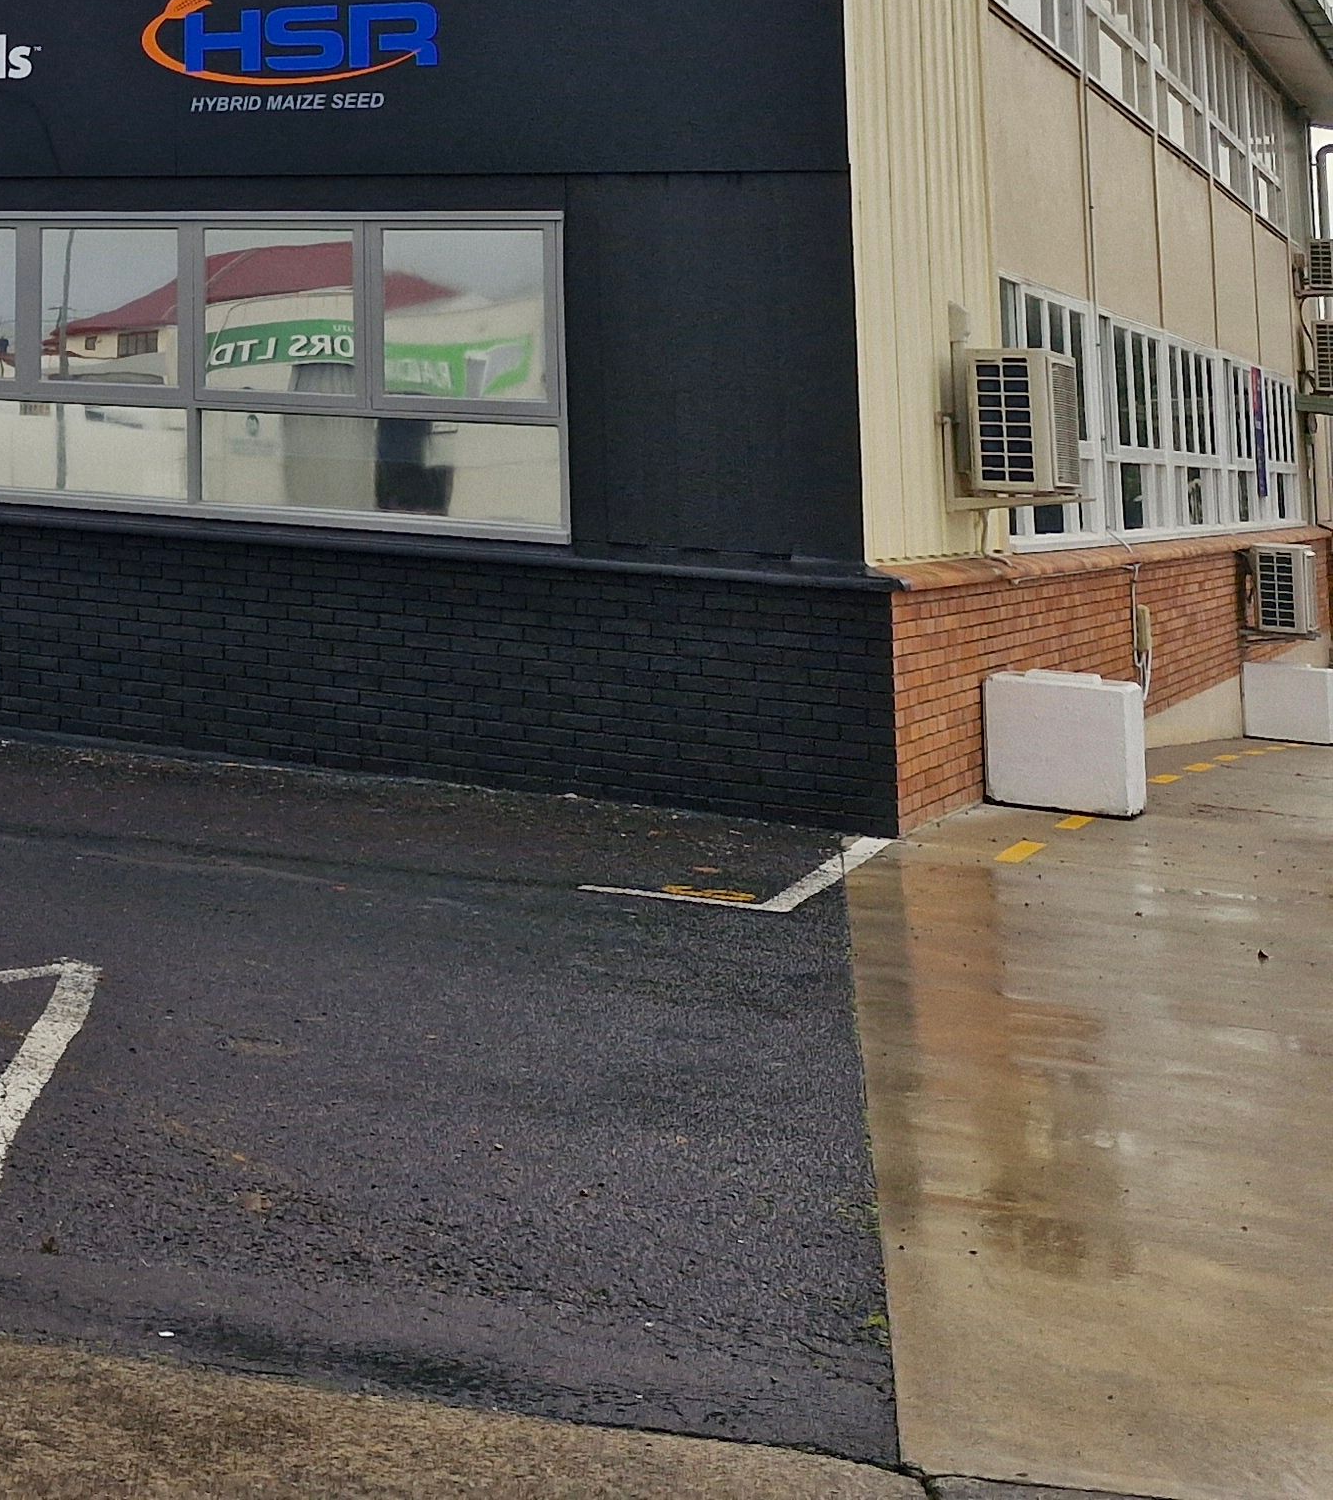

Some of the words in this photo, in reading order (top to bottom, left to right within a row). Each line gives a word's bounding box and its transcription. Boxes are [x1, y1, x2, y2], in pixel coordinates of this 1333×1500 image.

[184, 2, 438, 72] HSR
[190, 96, 261, 112] HYBRID
[266, 94, 327, 111] MAIZE
[331, 92, 385, 109] SEED
